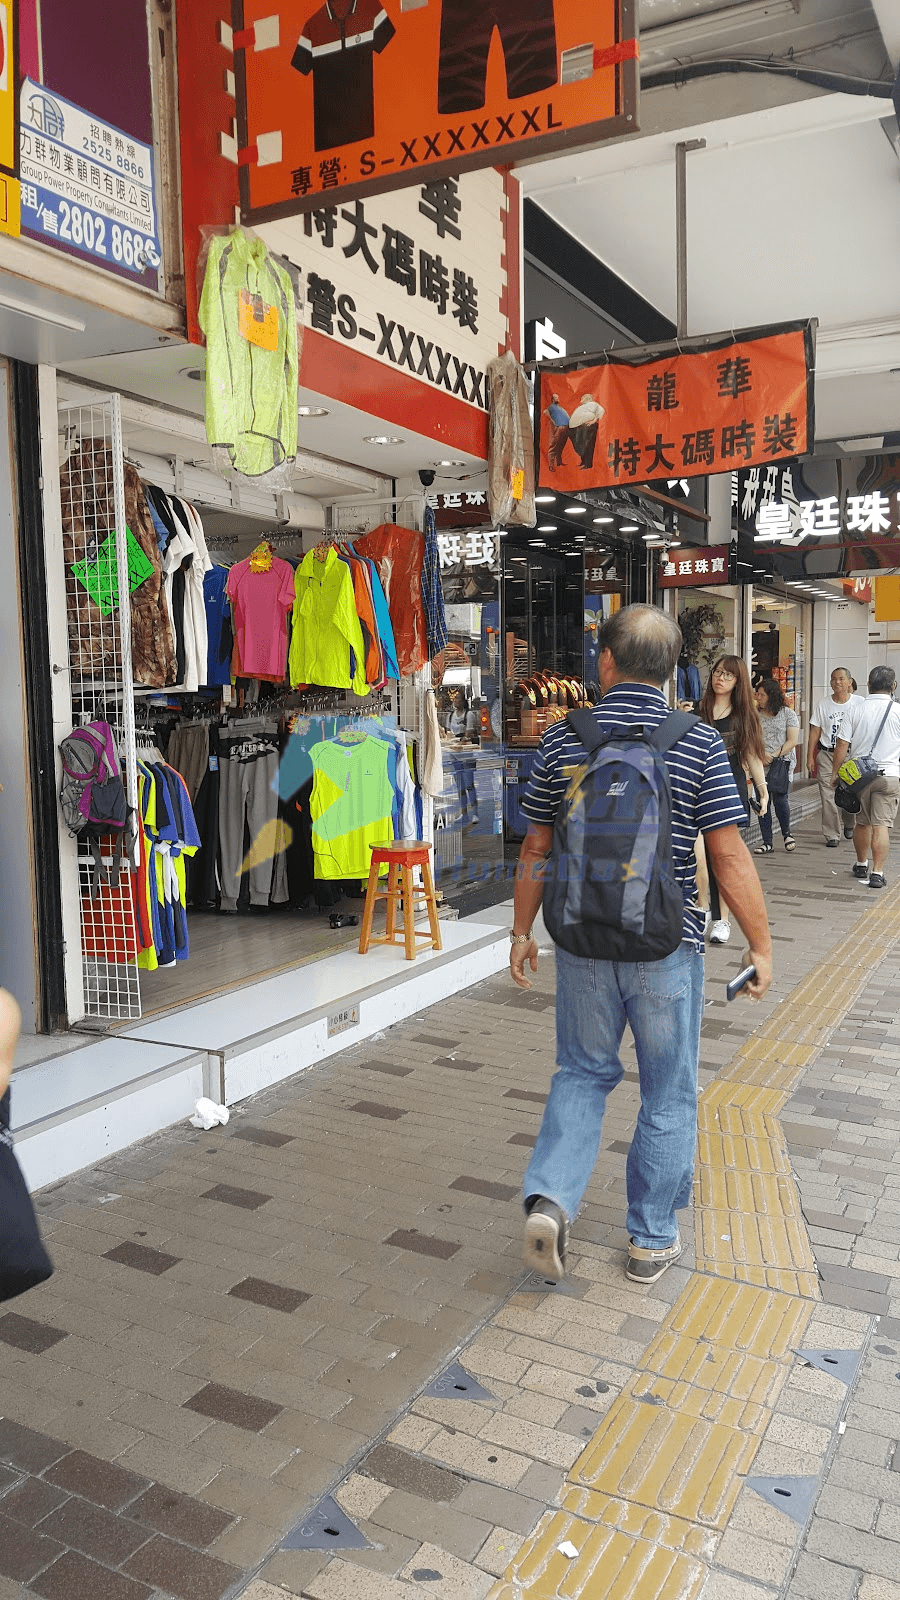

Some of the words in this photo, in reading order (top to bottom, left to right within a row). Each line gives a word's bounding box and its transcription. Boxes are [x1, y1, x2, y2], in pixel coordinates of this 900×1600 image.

[20, 130, 151, 212] 力群物業顧問有限公司
[83, 137, 112, 162] 2525
[116, 155, 144, 178] 8866
[359, 103, 563, 176] S-XXXXXXL
[20, 161, 42, 183] Group
[43, 171, 65, 191] Power
[66, 182, 93, 207] Property
[129, 212, 152, 231] Limited
[59, 200, 107, 255] 2802
[112, 224, 160, 270] 8686
[283, 254, 491, 413] 營S-XXXXXX
[646, 356, 753, 411] 龍華
[607, 412, 798, 478] 特大碼時裝
[754, 490, 900, 542] 皇廷珠
[662, 557, 725, 577] 皇廷珠寶
